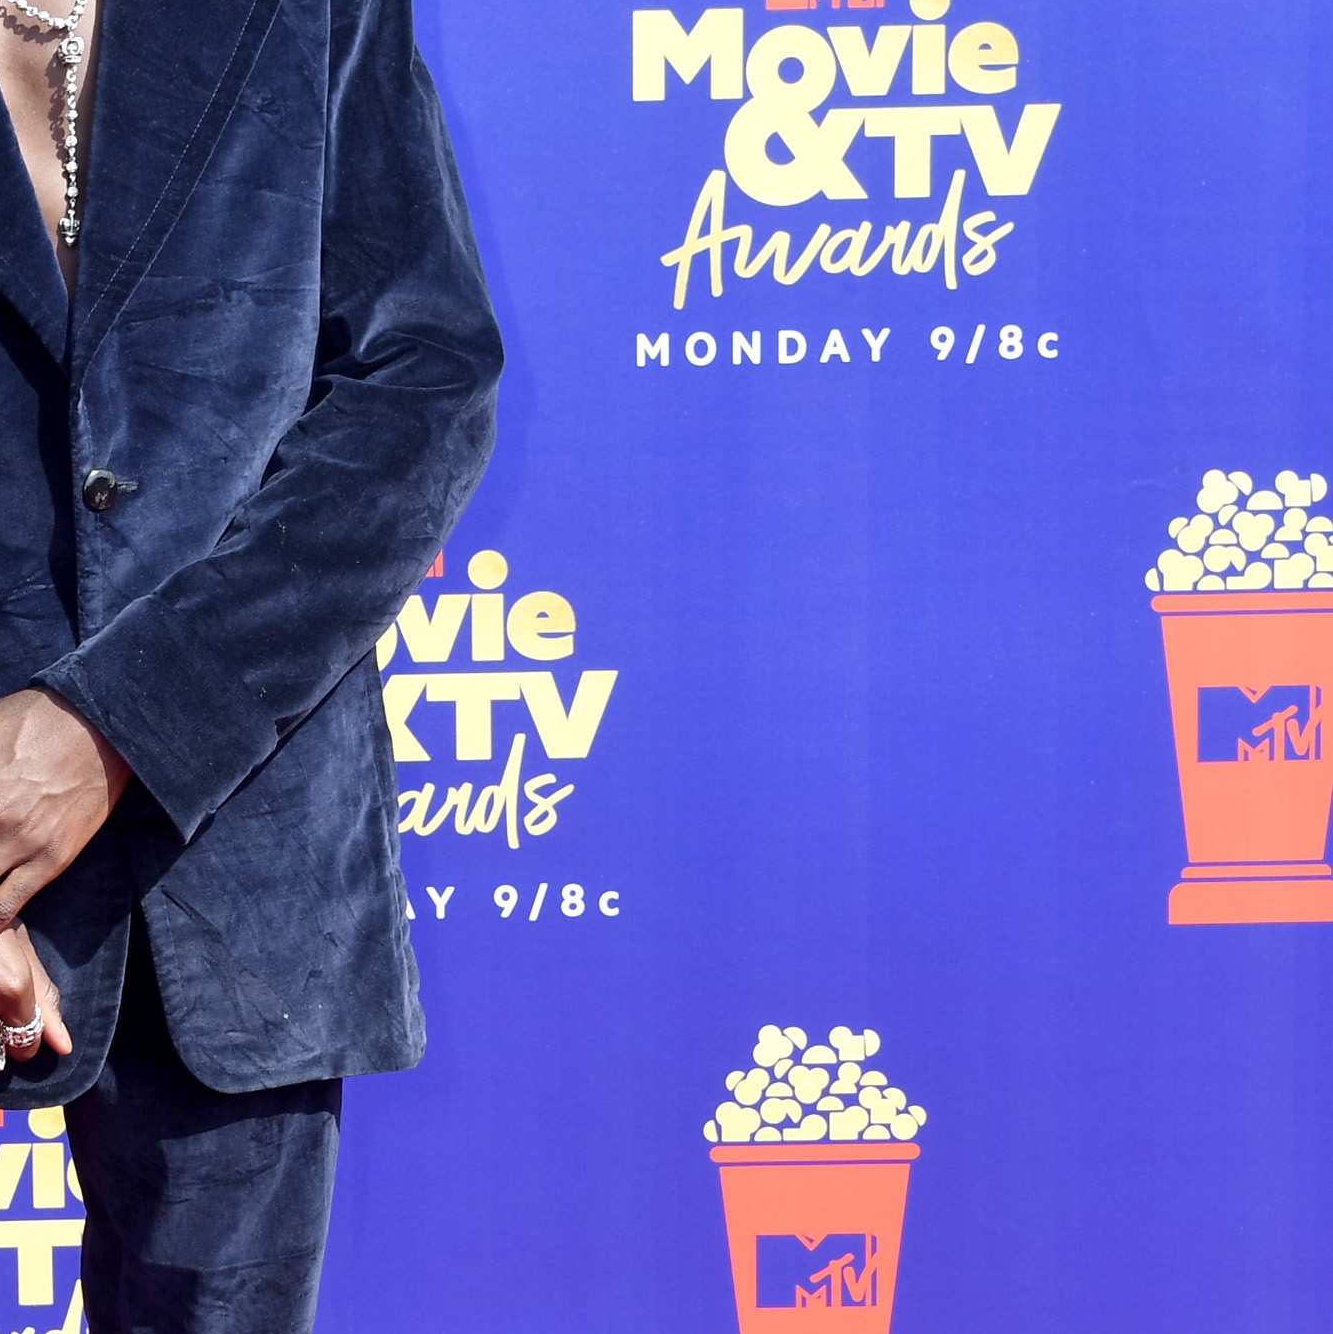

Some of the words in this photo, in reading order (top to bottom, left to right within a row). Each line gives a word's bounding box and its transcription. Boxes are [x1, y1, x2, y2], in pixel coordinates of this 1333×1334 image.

[660, 169, 1014, 309] Awards
[636, 328, 891, 367] MONDAY
[930, 324, 1059, 364] 9/8c
[1197, 684, 1323, 762] MTV
[493, 882, 620, 921] 9/8c
[756, 1233, 877, 1308] MTV
